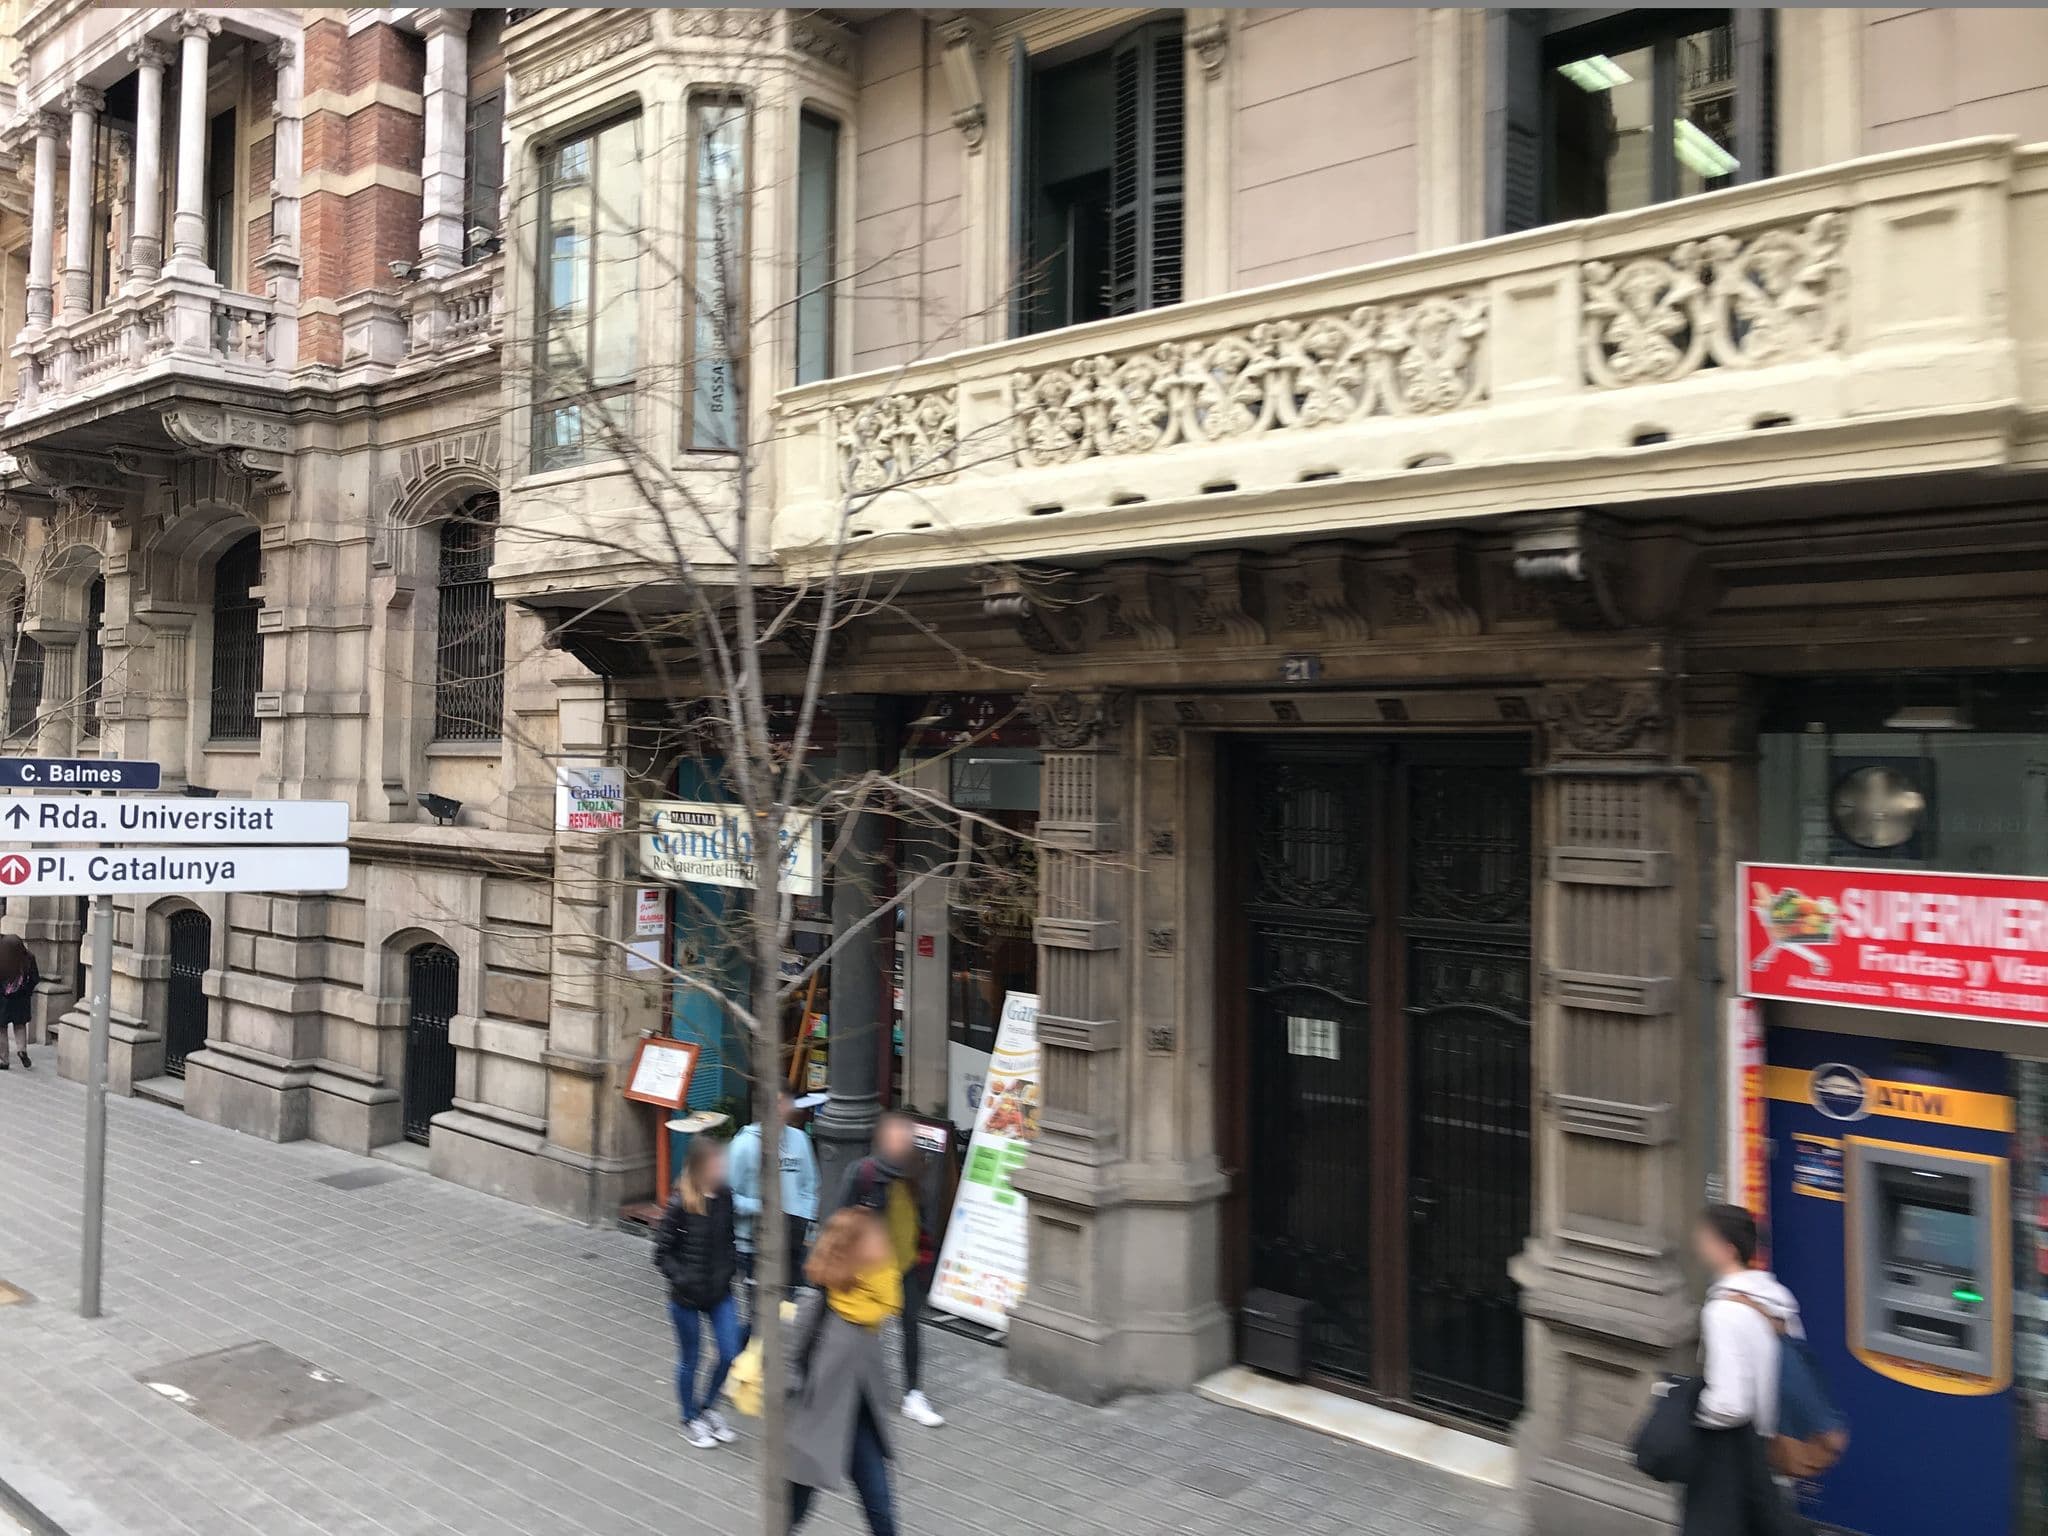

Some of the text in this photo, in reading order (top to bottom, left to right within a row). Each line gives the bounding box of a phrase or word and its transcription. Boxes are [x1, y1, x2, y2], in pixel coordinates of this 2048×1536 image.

[1286, 660, 1311, 680] 21
[21, 764, 122, 783] C. Balmes
[571, 784, 622, 800] Gandhi
[577, 800, 615, 812] INDIAN
[39, 803, 275, 830] Rda. Universitat
[568, 811, 623, 829] RESTAURANTE
[671, 811, 715, 826] MAHATMA
[37, 855, 236, 885] Pl. Catalunya
[653, 855, 722, 878] Restaurante
[1859, 944, 1966, 979] Frutas
[1964, 960, 1992, 988] y
[1877, 1086, 1944, 1117] ATM
